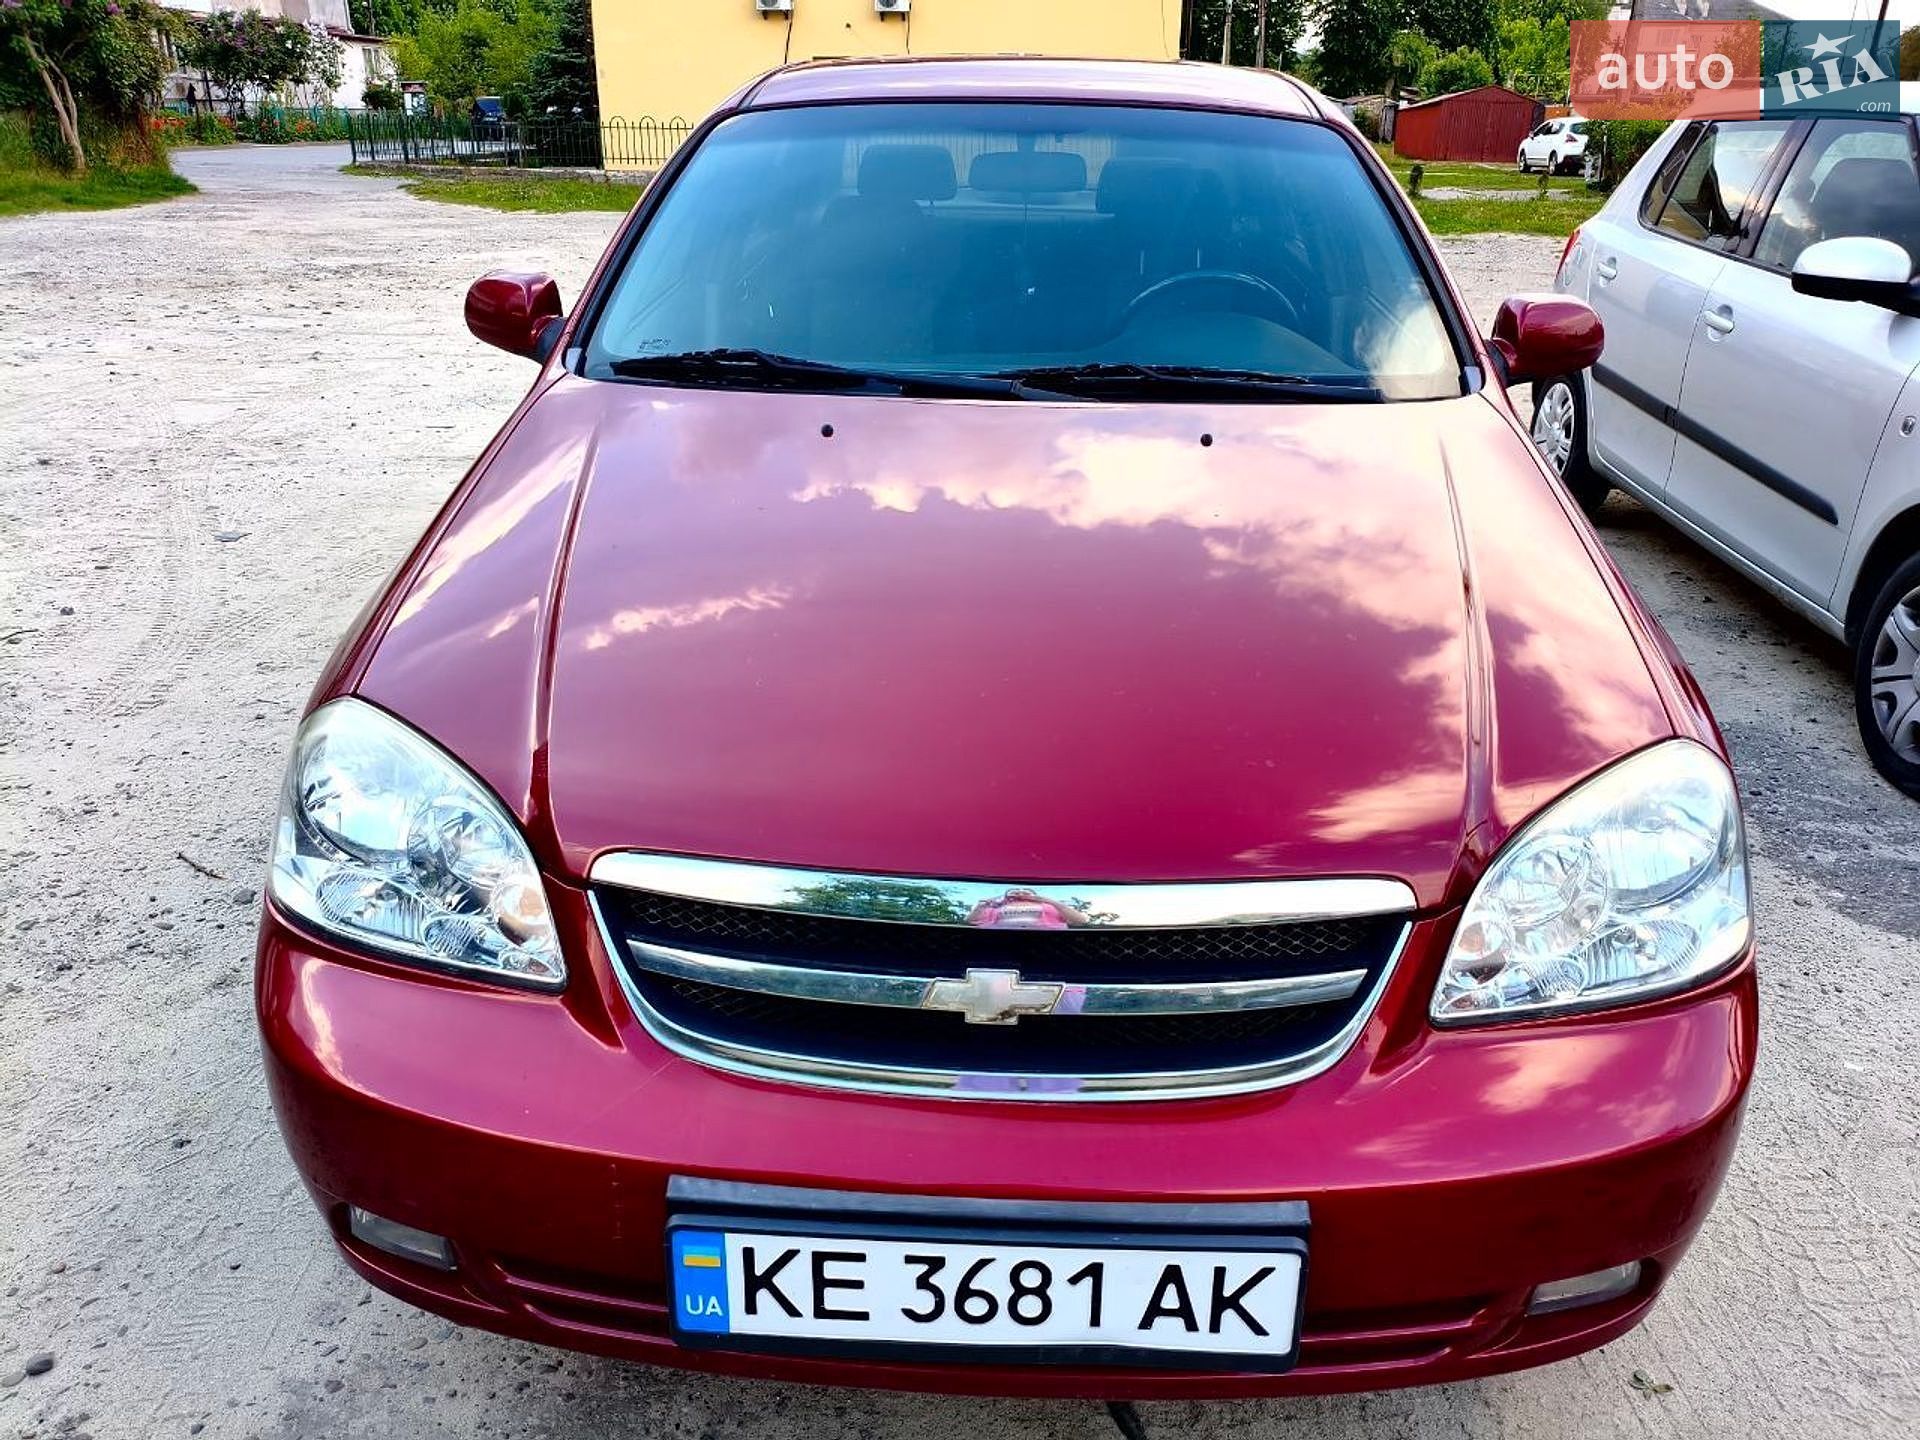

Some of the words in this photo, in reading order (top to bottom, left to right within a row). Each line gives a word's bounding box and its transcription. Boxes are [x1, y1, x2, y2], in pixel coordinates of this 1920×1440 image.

[685, 1294, 723, 1317] UA
[742, 1246, 870, 1322] KE
[900, 1254, 1105, 1328] 3681
[1137, 1263, 1277, 1337] AK
